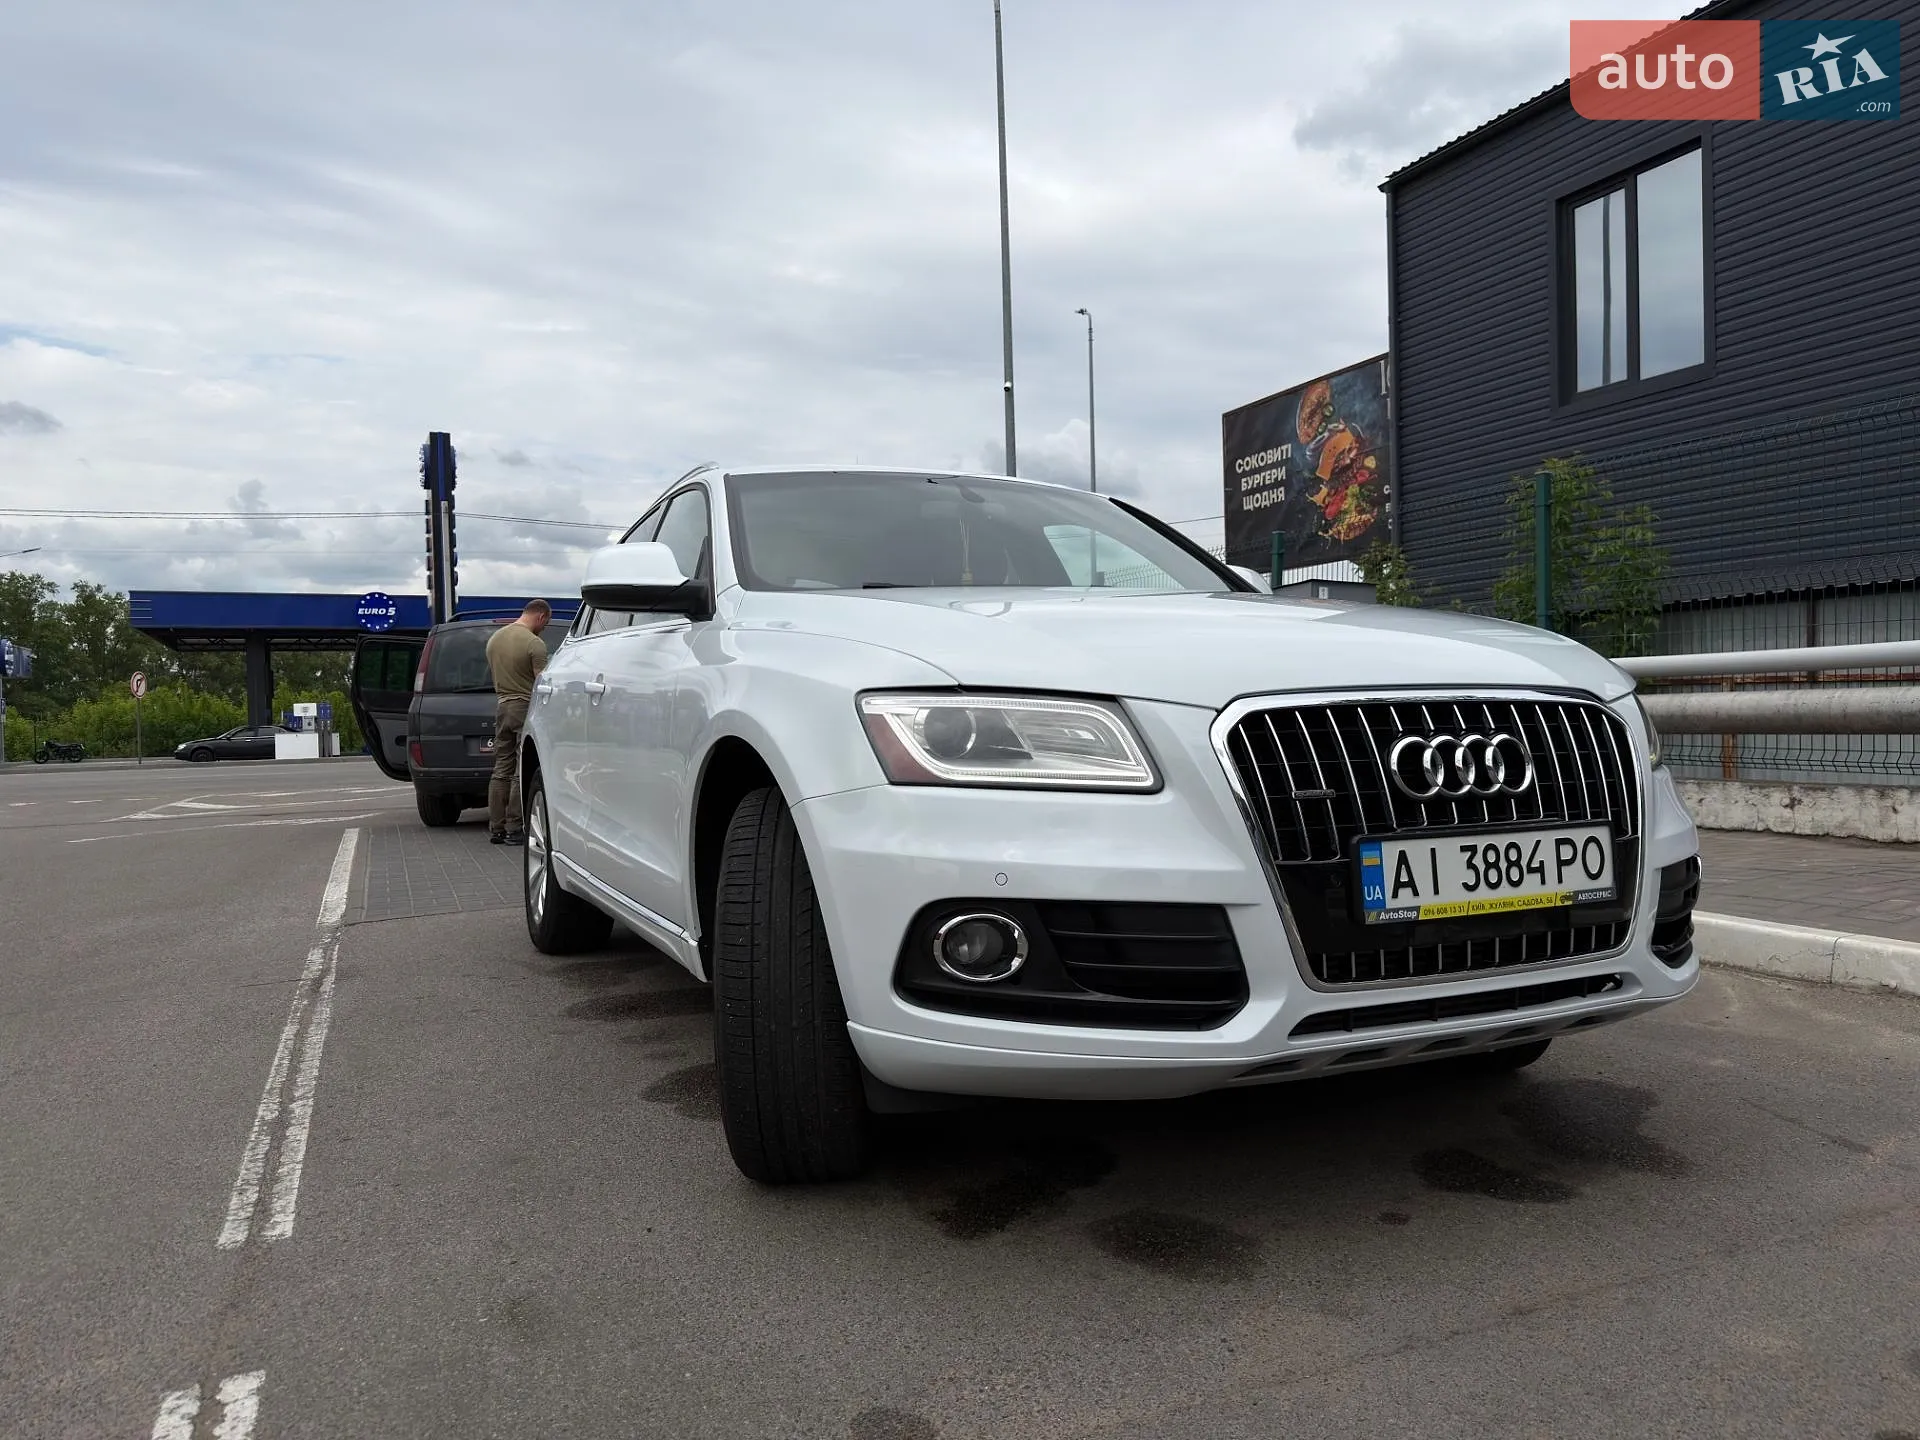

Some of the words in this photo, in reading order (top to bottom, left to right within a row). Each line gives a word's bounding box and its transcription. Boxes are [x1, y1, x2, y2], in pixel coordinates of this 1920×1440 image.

[1235, 443, 1292, 474] СОКОВИТІ
[1241, 466, 1286, 492] БУРГЕРИ
[1242, 486, 1285, 511] ЩОДНЯ
[357, 607, 387, 615] EURO
[387, 607, 396, 616] 5
[1460, 839, 1546, 892] 3884
[1364, 885, 1383, 900] UA
[1380, 910, 1417, 920] AvtoStop
